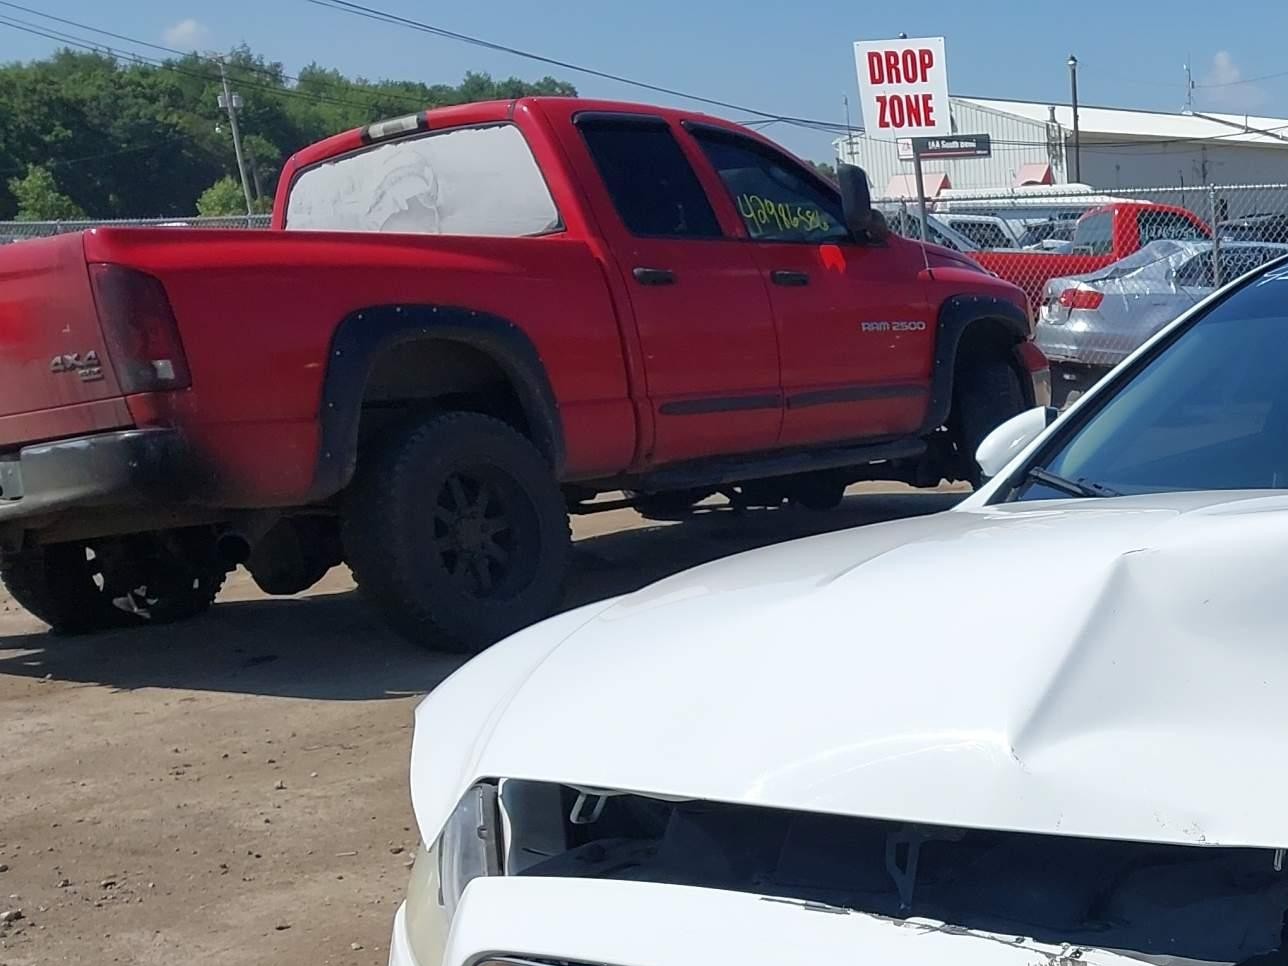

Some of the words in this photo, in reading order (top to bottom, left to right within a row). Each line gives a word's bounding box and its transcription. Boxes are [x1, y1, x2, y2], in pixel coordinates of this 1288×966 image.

[867, 49, 934, 84] DROP
[875, 93, 936, 128] ZONE
[861, 321, 890, 332] RAM
[891, 321, 926, 331] 2500
